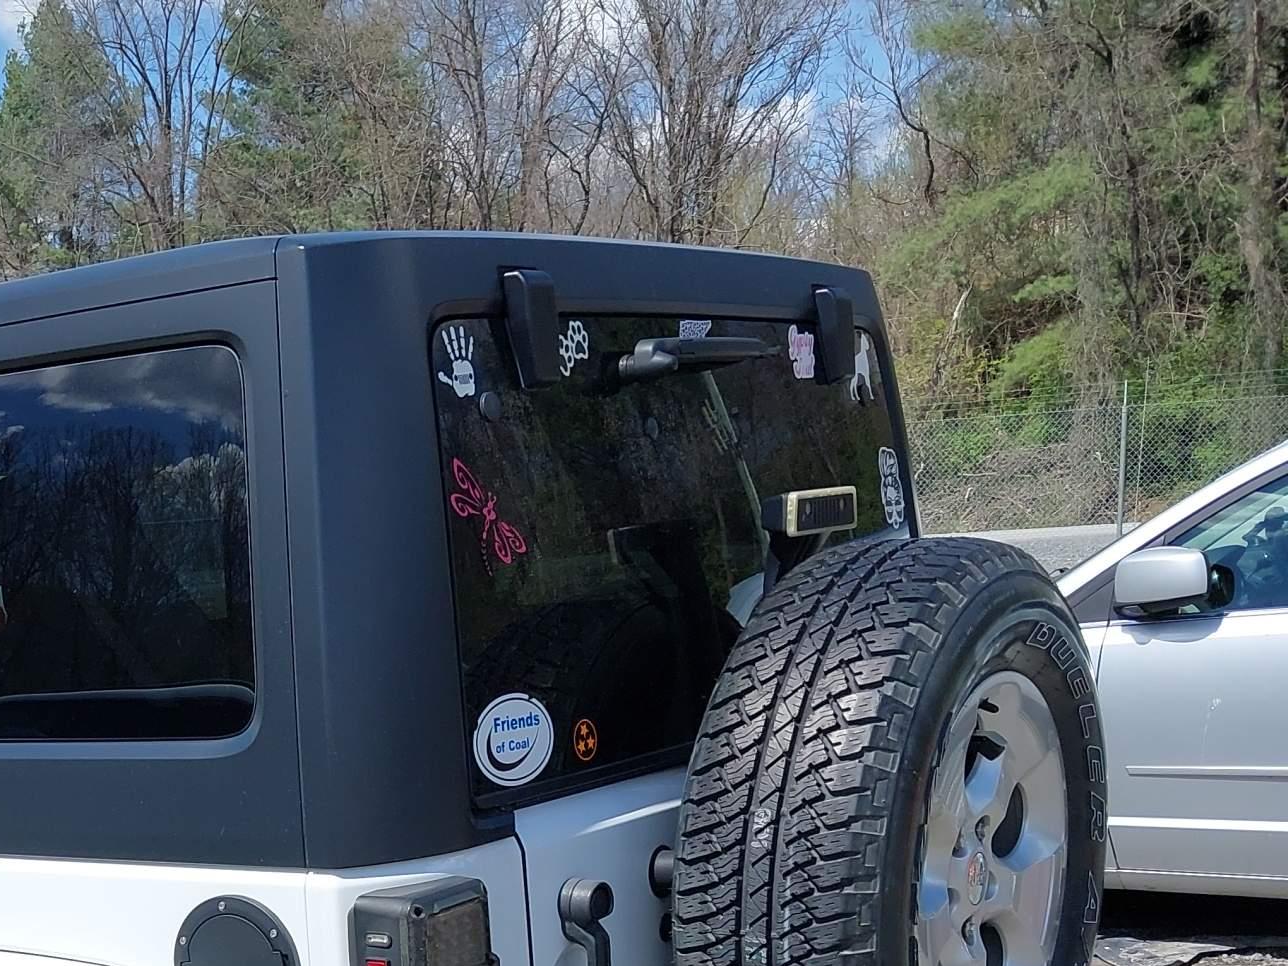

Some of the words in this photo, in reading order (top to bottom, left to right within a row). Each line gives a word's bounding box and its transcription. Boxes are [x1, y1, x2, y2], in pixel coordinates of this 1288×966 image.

[494, 712, 540, 733] Friends
[1026, 622, 1105, 843] DUELER
[496, 743, 506, 754] of
[509, 737, 530, 751] Coal
